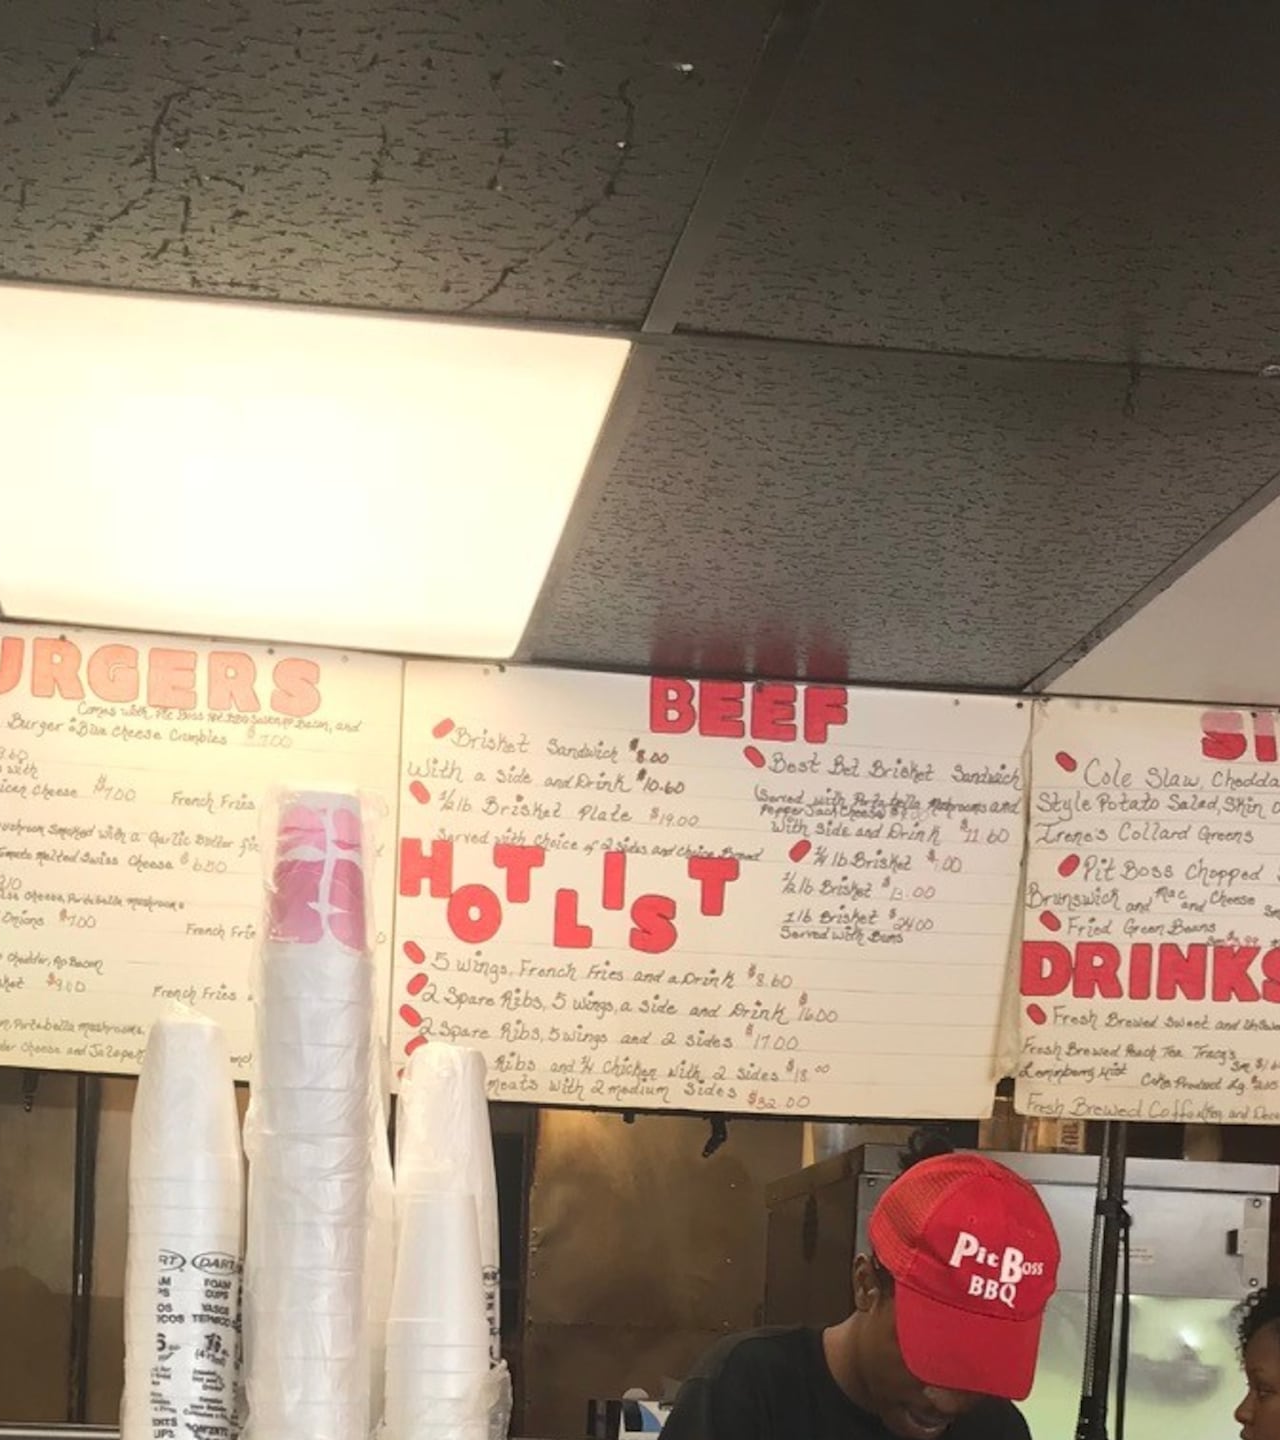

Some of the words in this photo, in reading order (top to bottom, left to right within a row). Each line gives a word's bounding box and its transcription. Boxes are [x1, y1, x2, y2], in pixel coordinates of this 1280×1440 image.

[649, 676, 849, 744] BEEF
[450, 727, 532, 760] Brisket
[546, 738, 620, 767] Sandwich
[473, 770, 487, 787] a
[496, 764, 533, 785] side
[543, 769, 576, 788] and
[575, 768, 632, 793] Drink
[871, 756, 936, 785] Brisket
[950, 760, 1026, 790] Sandwich
[1083, 757, 1133, 789] Cole
[171, 789, 214, 814] French
[220, 792, 257, 811] Fries
[480, 792, 562, 821] Brisket
[576, 802, 632, 824] Plate
[1036, 792, 1093, 822] Style
[1098, 797, 1160, 813] Potato
[855, 825, 882, 840] and
[888, 820, 942, 847] Drink
[1119, 820, 1192, 843] Collard
[1197, 824, 1256, 847] Greens
[126, 852, 174, 877] Cheese
[850, 847, 914, 872] Brisket
[1082, 854, 1117, 882] Pit
[1120, 860, 1176, 881] Boss
[1183, 858, 1267, 888] Chopped
[398, 836, 546, 944] HOT
[552, 850, 741, 955] LIST
[818, 874, 876, 902] Brisket
[1125, 899, 1154, 914] and
[1209, 889, 1258, 910] Cheese
[818, 903, 880, 928] Brisket
[1065, 915, 1114, 936] Fried
[1122, 918, 1167, 936] Green
[1168, 920, 1219, 936] Beans
[185, 921, 226, 945] French
[779, 926, 830, 944] Served
[429, 951, 450, 972] 5
[519, 957, 577, 982] French
[585, 959, 625, 982] Fries
[632, 968, 663, 987] and
[680, 967, 737, 989] Drink
[151, 983, 198, 1009] French
[201, 982, 238, 1003] Fries
[421, 983, 440, 1006] 2
[442, 984, 496, 1012] Spare
[637, 993, 678, 1016] side
[688, 1002, 719, 1019] and
[727, 998, 790, 1027] Drink
[1053, 1003, 1099, 1028] Fresh
[1104, 1009, 1158, 1031] Brewed
[1164, 1012, 1210, 1030] Sweet
[418, 1015, 436, 1038] 2
[438, 1019, 492, 1043] Spare
[619, 1033, 650, 1049] and
[661, 1030, 678, 1047] 2
[684, 1028, 735, 1050] sides
[1022, 1036, 1062, 1063] Fresh
[1067, 1041, 1126, 1060] Brewed
[494, 1050, 539, 1075] Ribs
[549, 1058, 579, 1075] and
[601, 1055, 658, 1081] Chicken
[711, 1063, 727, 1082] 2
[736, 1061, 782, 1083] sides
[548, 1076, 585, 1101] with
[589, 1080, 606, 1098] 2
[607, 1077, 671, 1105] medium
[1025, 1093, 1067, 1117] Fresh
[1073, 1097, 1143, 1118] Brewed
[967, 1274, 1018, 1309] BBQ
